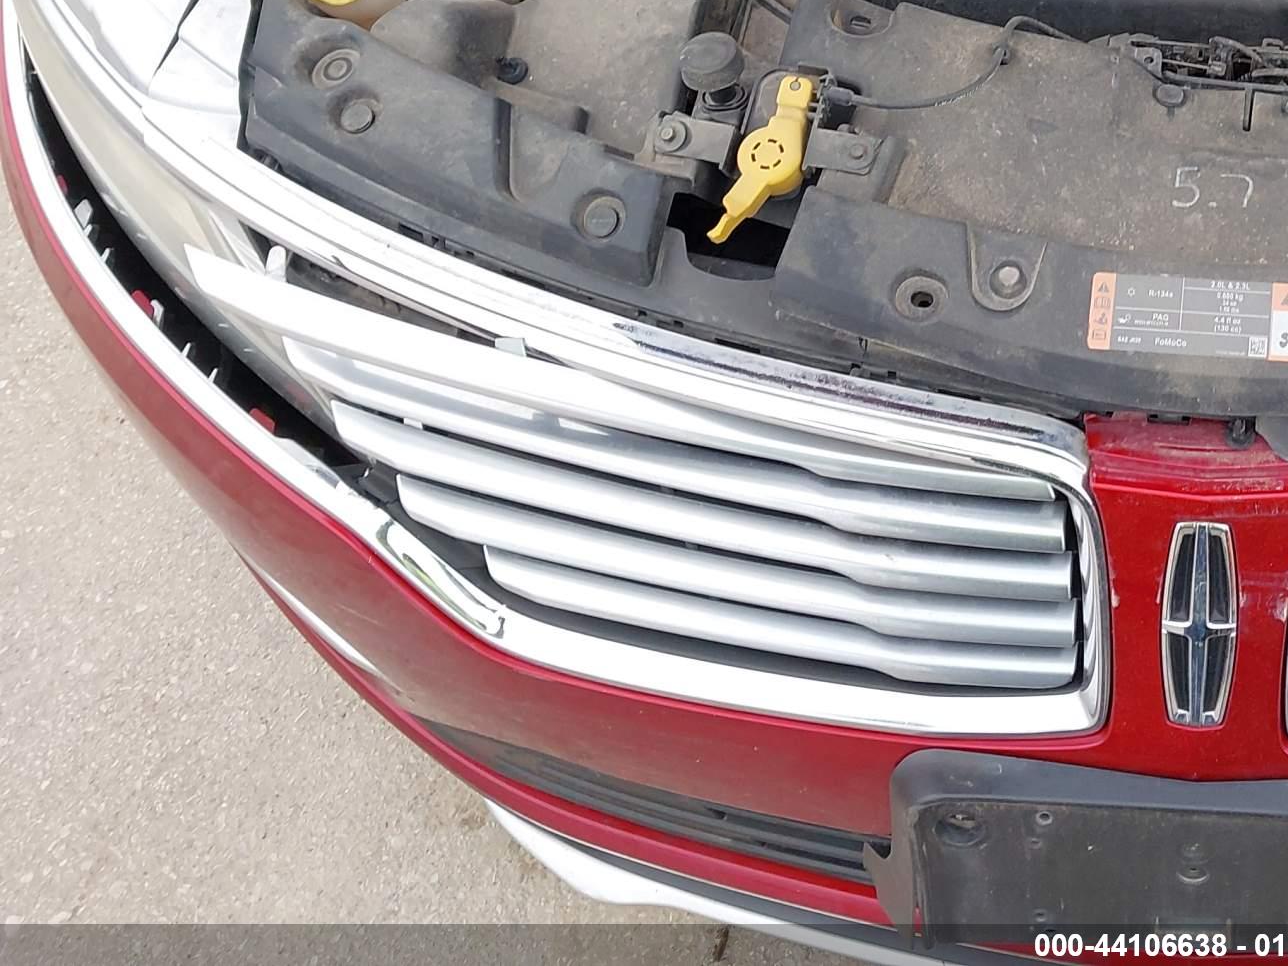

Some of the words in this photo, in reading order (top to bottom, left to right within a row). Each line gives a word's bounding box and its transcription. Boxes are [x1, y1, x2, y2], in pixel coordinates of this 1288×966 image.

[1172, 166, 1254, 208] 5.7
[1148, 289, 1174, 299] R-134a
[1154, 336, 1187, 347] FoMoCo
